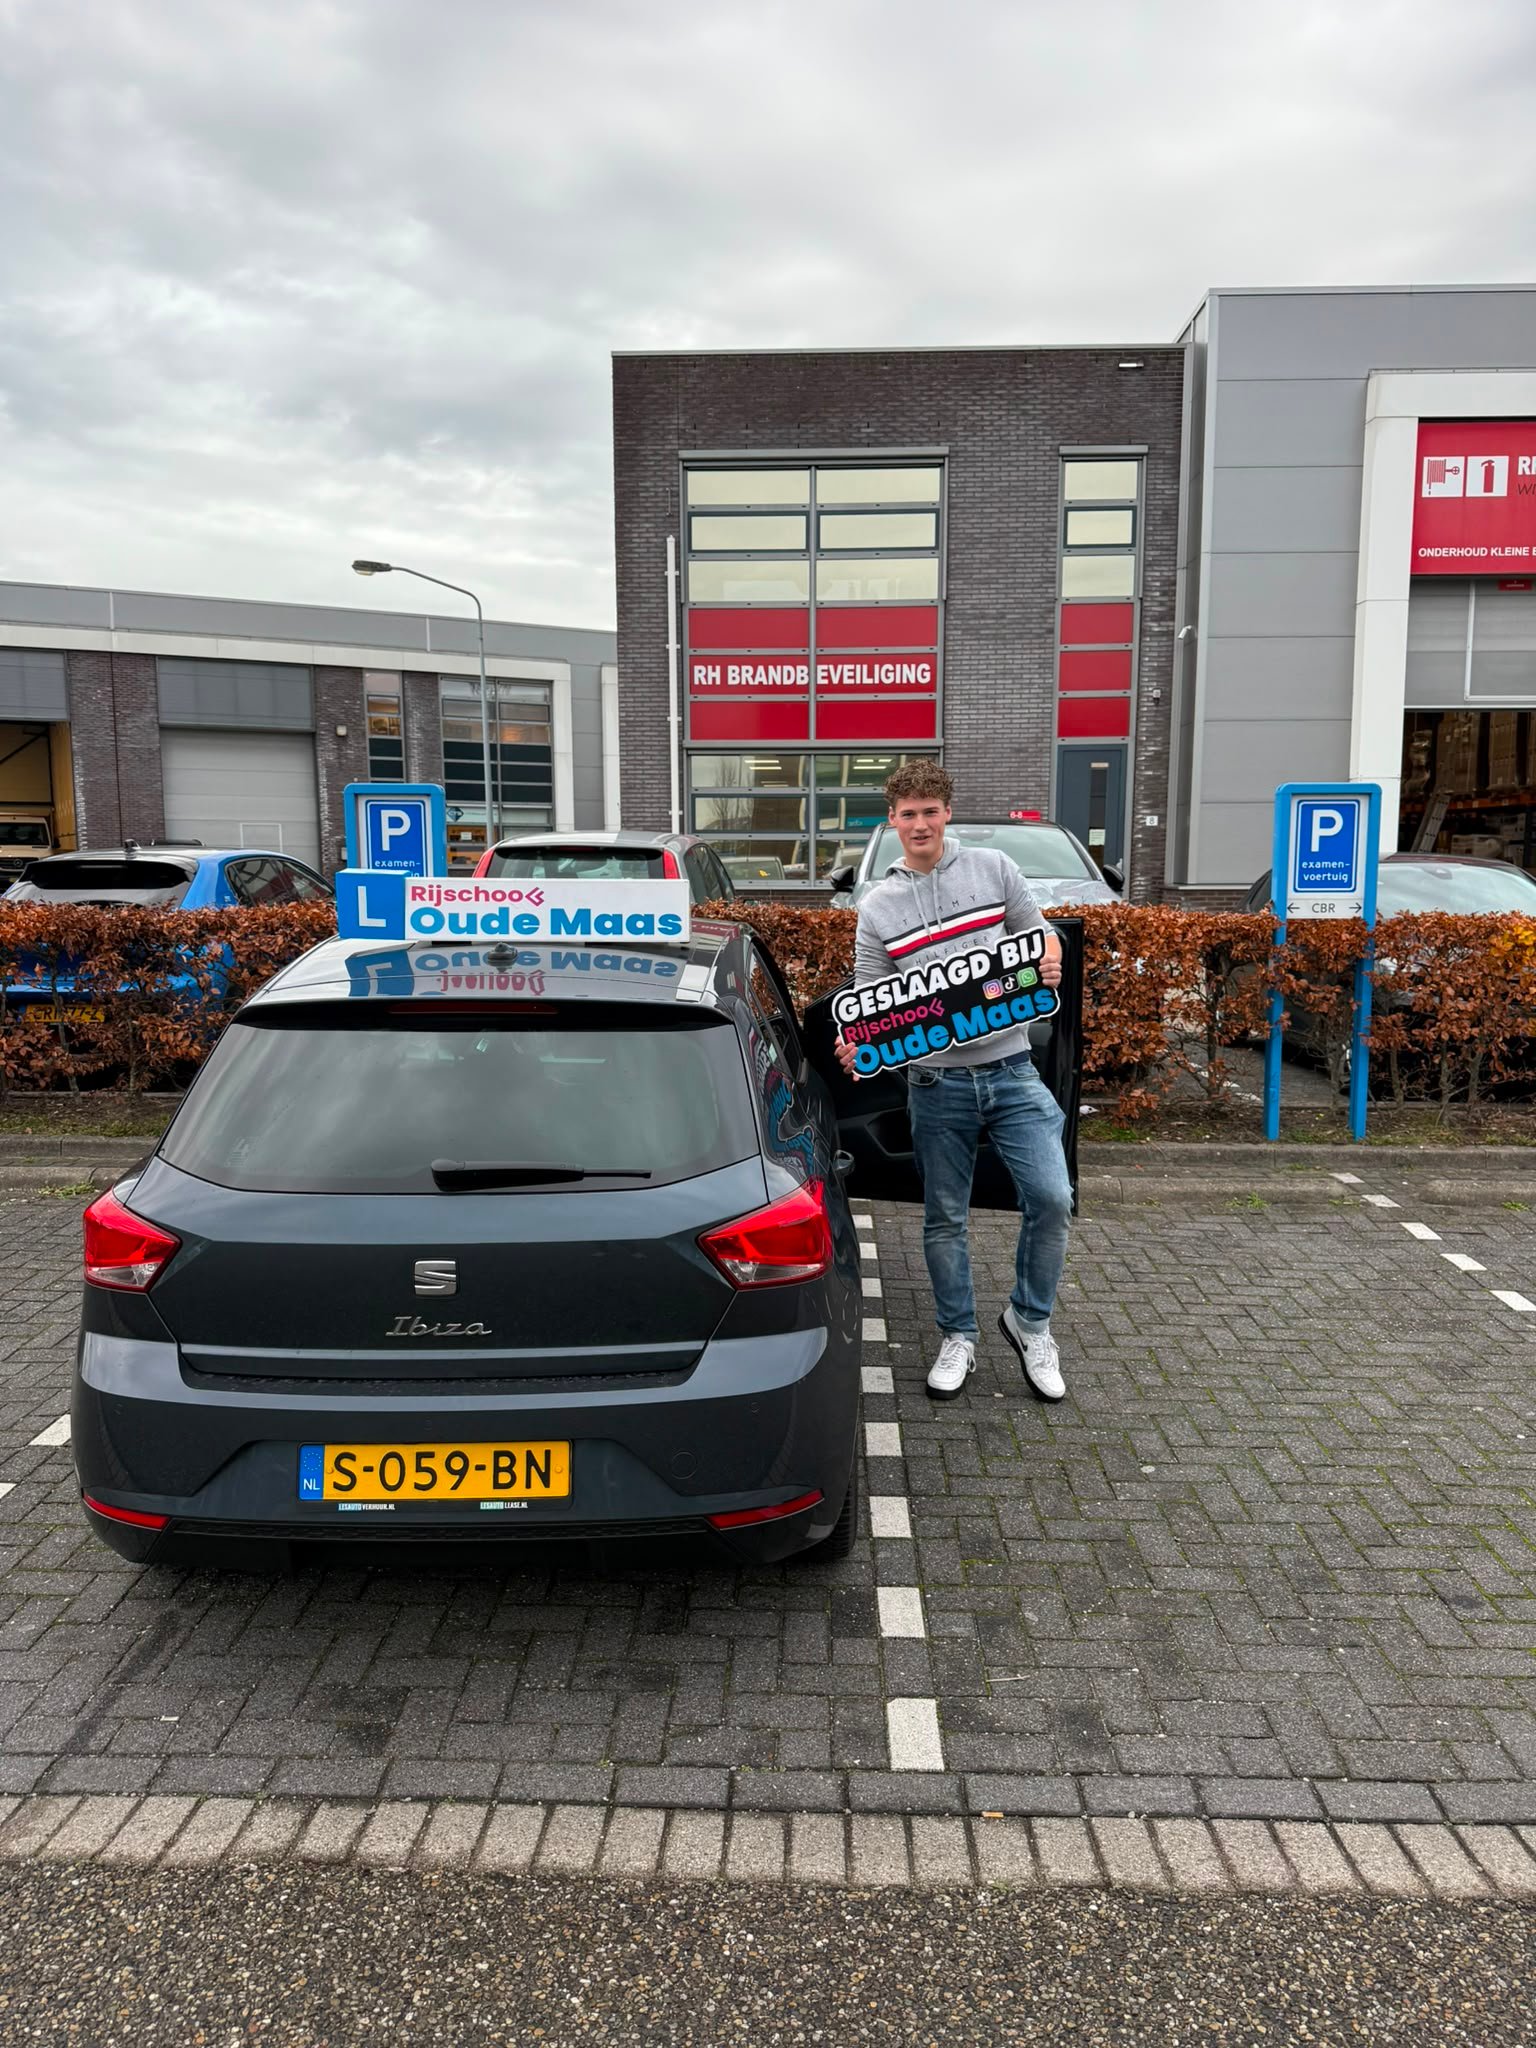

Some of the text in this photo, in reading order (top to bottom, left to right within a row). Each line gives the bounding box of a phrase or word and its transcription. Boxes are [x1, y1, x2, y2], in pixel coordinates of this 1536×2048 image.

[1418, 547, 1488, 557] ONDERHOUD
[1490, 546, 1530, 557] KLEINE
[693, 663, 931, 685] RH BRANDBEVEILIGING
[1010, 811, 1023, 819] 6-8
[380, 809, 411, 851] P
[1310, 809, 1344, 852] P
[374, 860, 421, 868] examen-
[1302, 860, 1350, 869] examen-
[1303, 872, 1348, 883] voertuig
[357, 885, 387, 927] L
[903, 894, 977, 926] TMY
[1311, 903, 1336, 913] CBR
[410, 906, 683, 936] Oude Maas
[838, 932, 1044, 1023] GESLAAGD BIJ
[854, 988, 1056, 1073] Oude Maas
[385, 1316, 493, 1336] Ibiza
[332, 1449, 551, 1492] S-059-BN
[303, 1480, 320, 1491] NL
